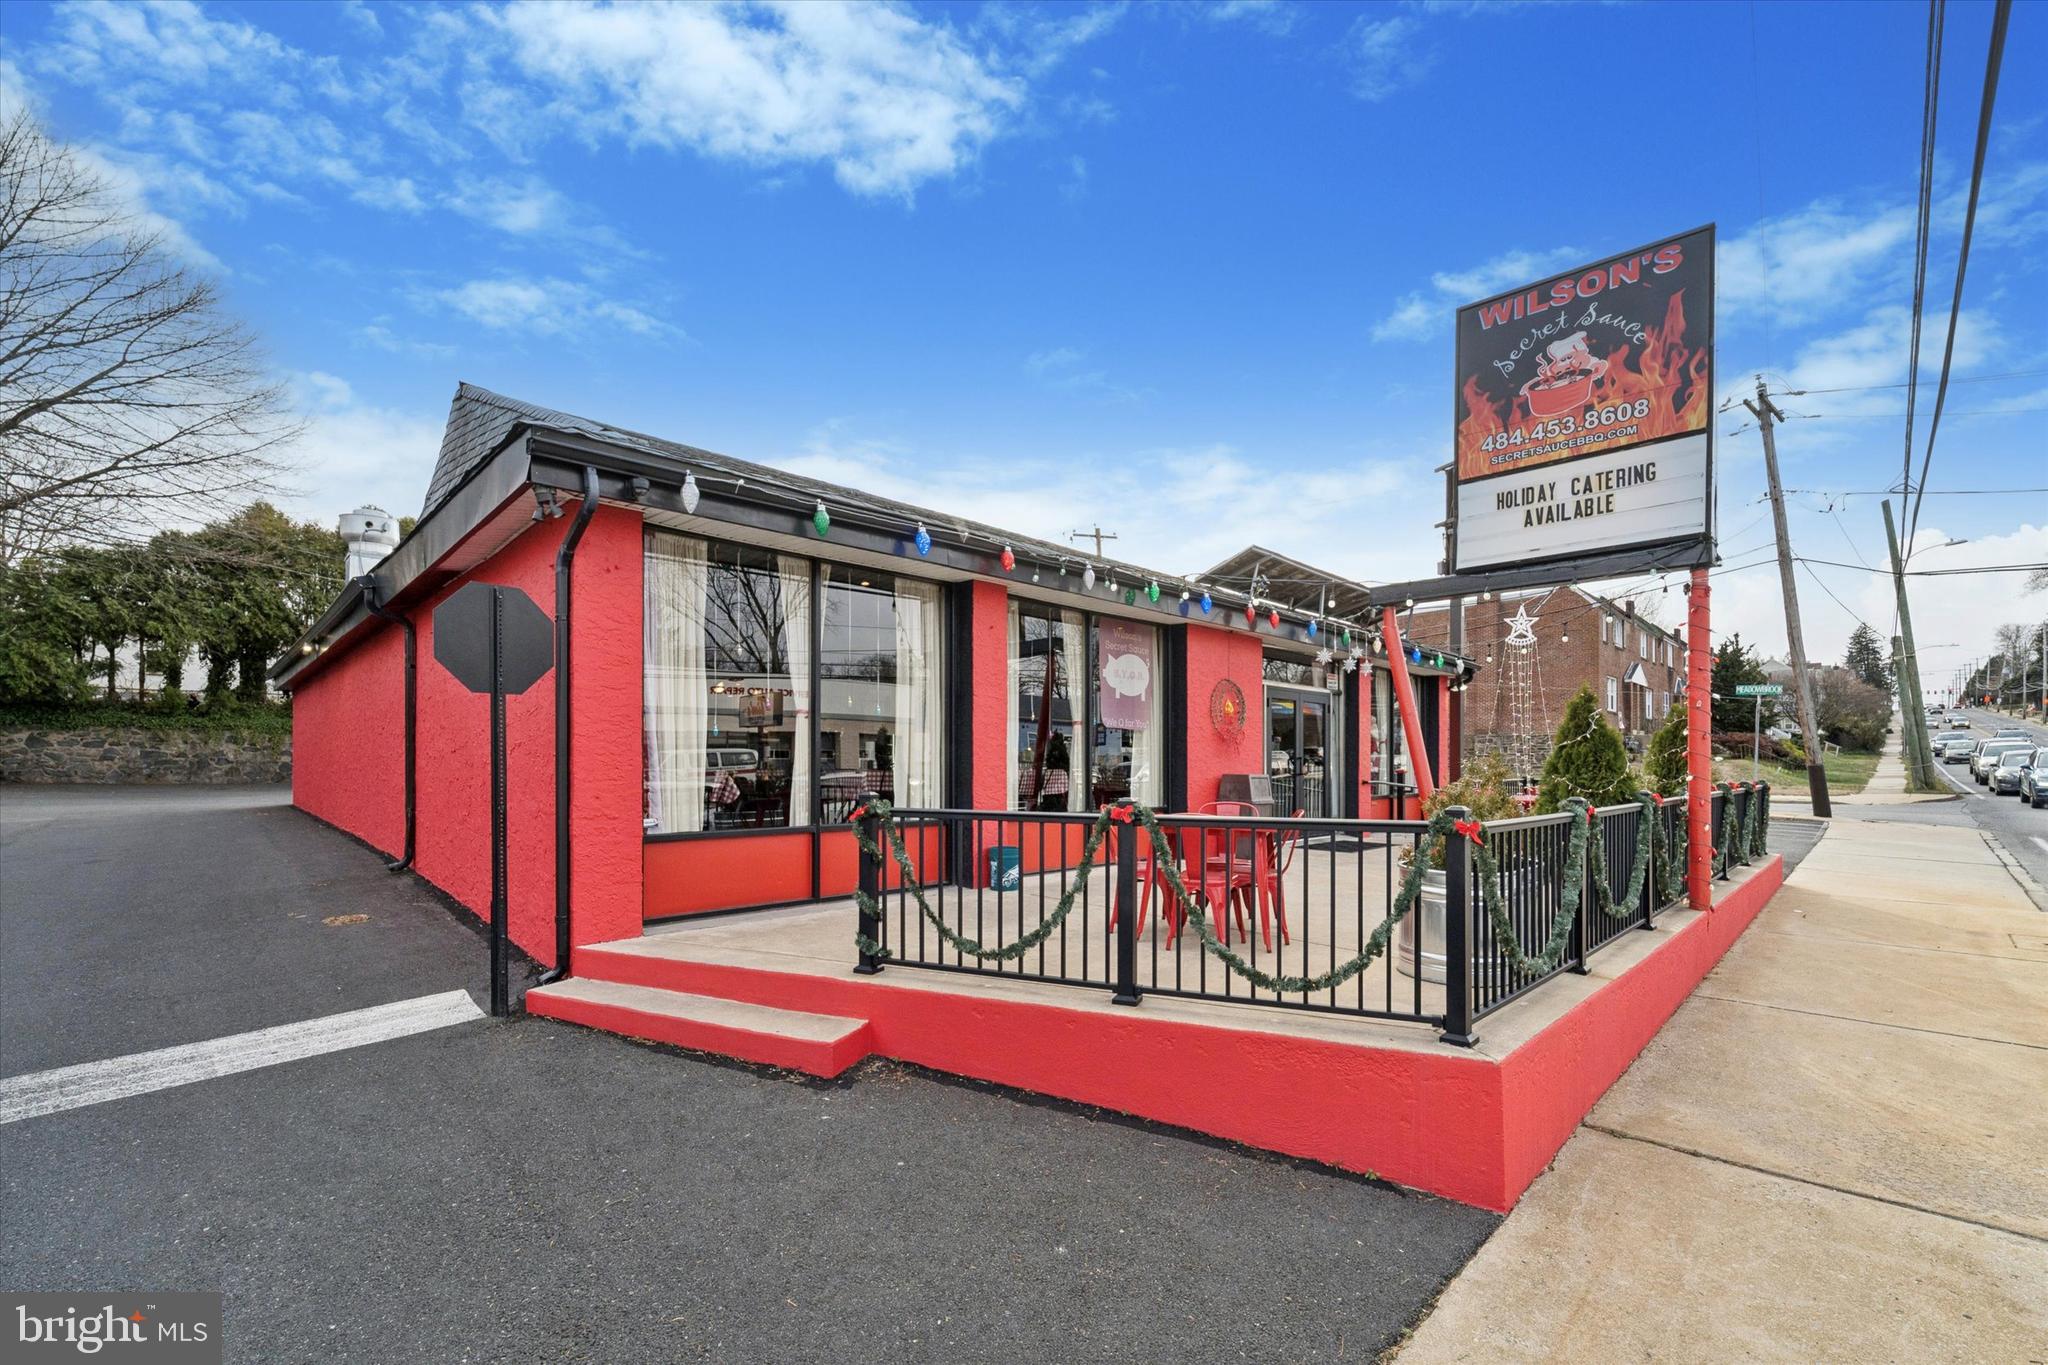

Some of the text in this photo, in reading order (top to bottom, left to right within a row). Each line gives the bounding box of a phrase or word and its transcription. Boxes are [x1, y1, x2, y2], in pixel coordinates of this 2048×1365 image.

[1478, 244, 1684, 330] WILSON'S
[1492, 301, 1647, 379] Secret Sauce
[1481, 398, 1650, 453] 484.453.8608
[1490, 425, 1639, 465] SECRETSAUCEBBQ.COM
[1496, 462, 1657, 510] HOLIDAY CATERING
[1523, 493, 1614, 528] AVAILABLE
